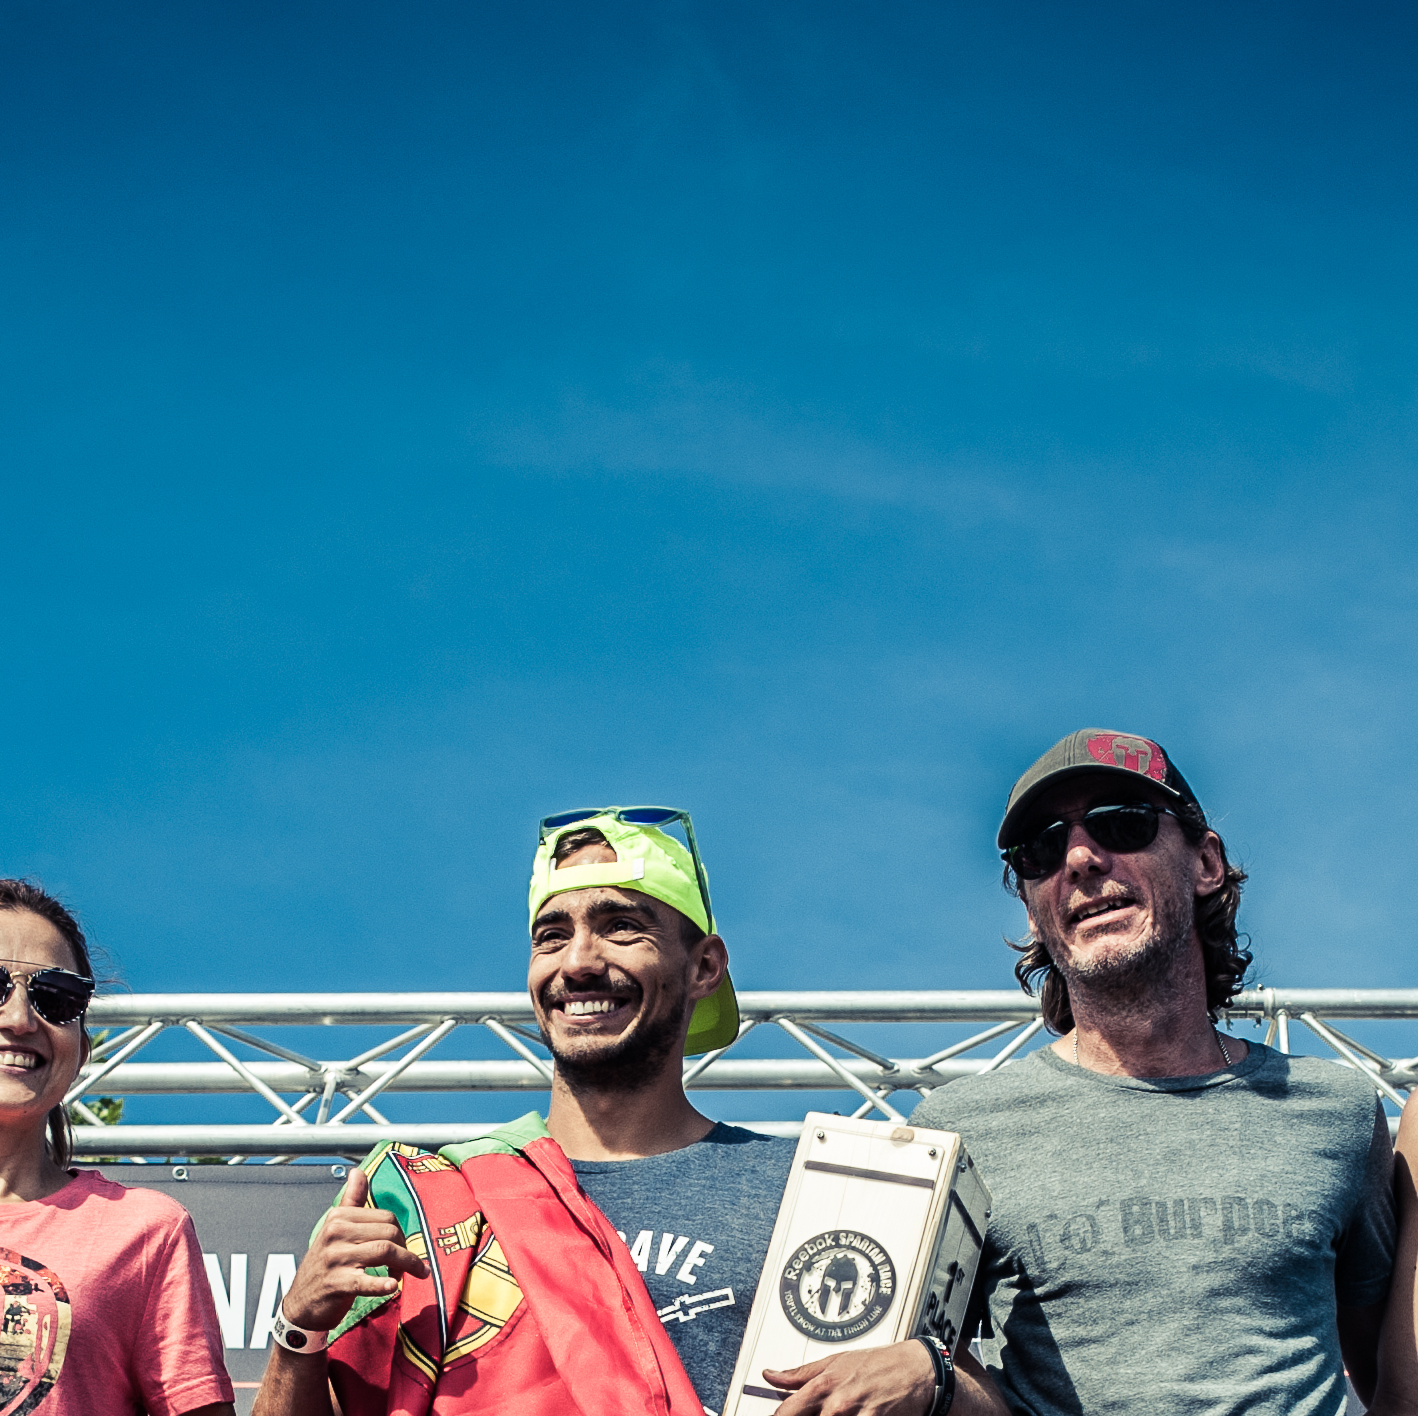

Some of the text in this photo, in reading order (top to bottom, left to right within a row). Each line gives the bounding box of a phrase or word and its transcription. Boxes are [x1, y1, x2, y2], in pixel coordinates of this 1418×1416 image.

[618, 1229, 715, 1285] AVE
[784, 1232, 893, 1295] Reebok SPARTAN RACE
